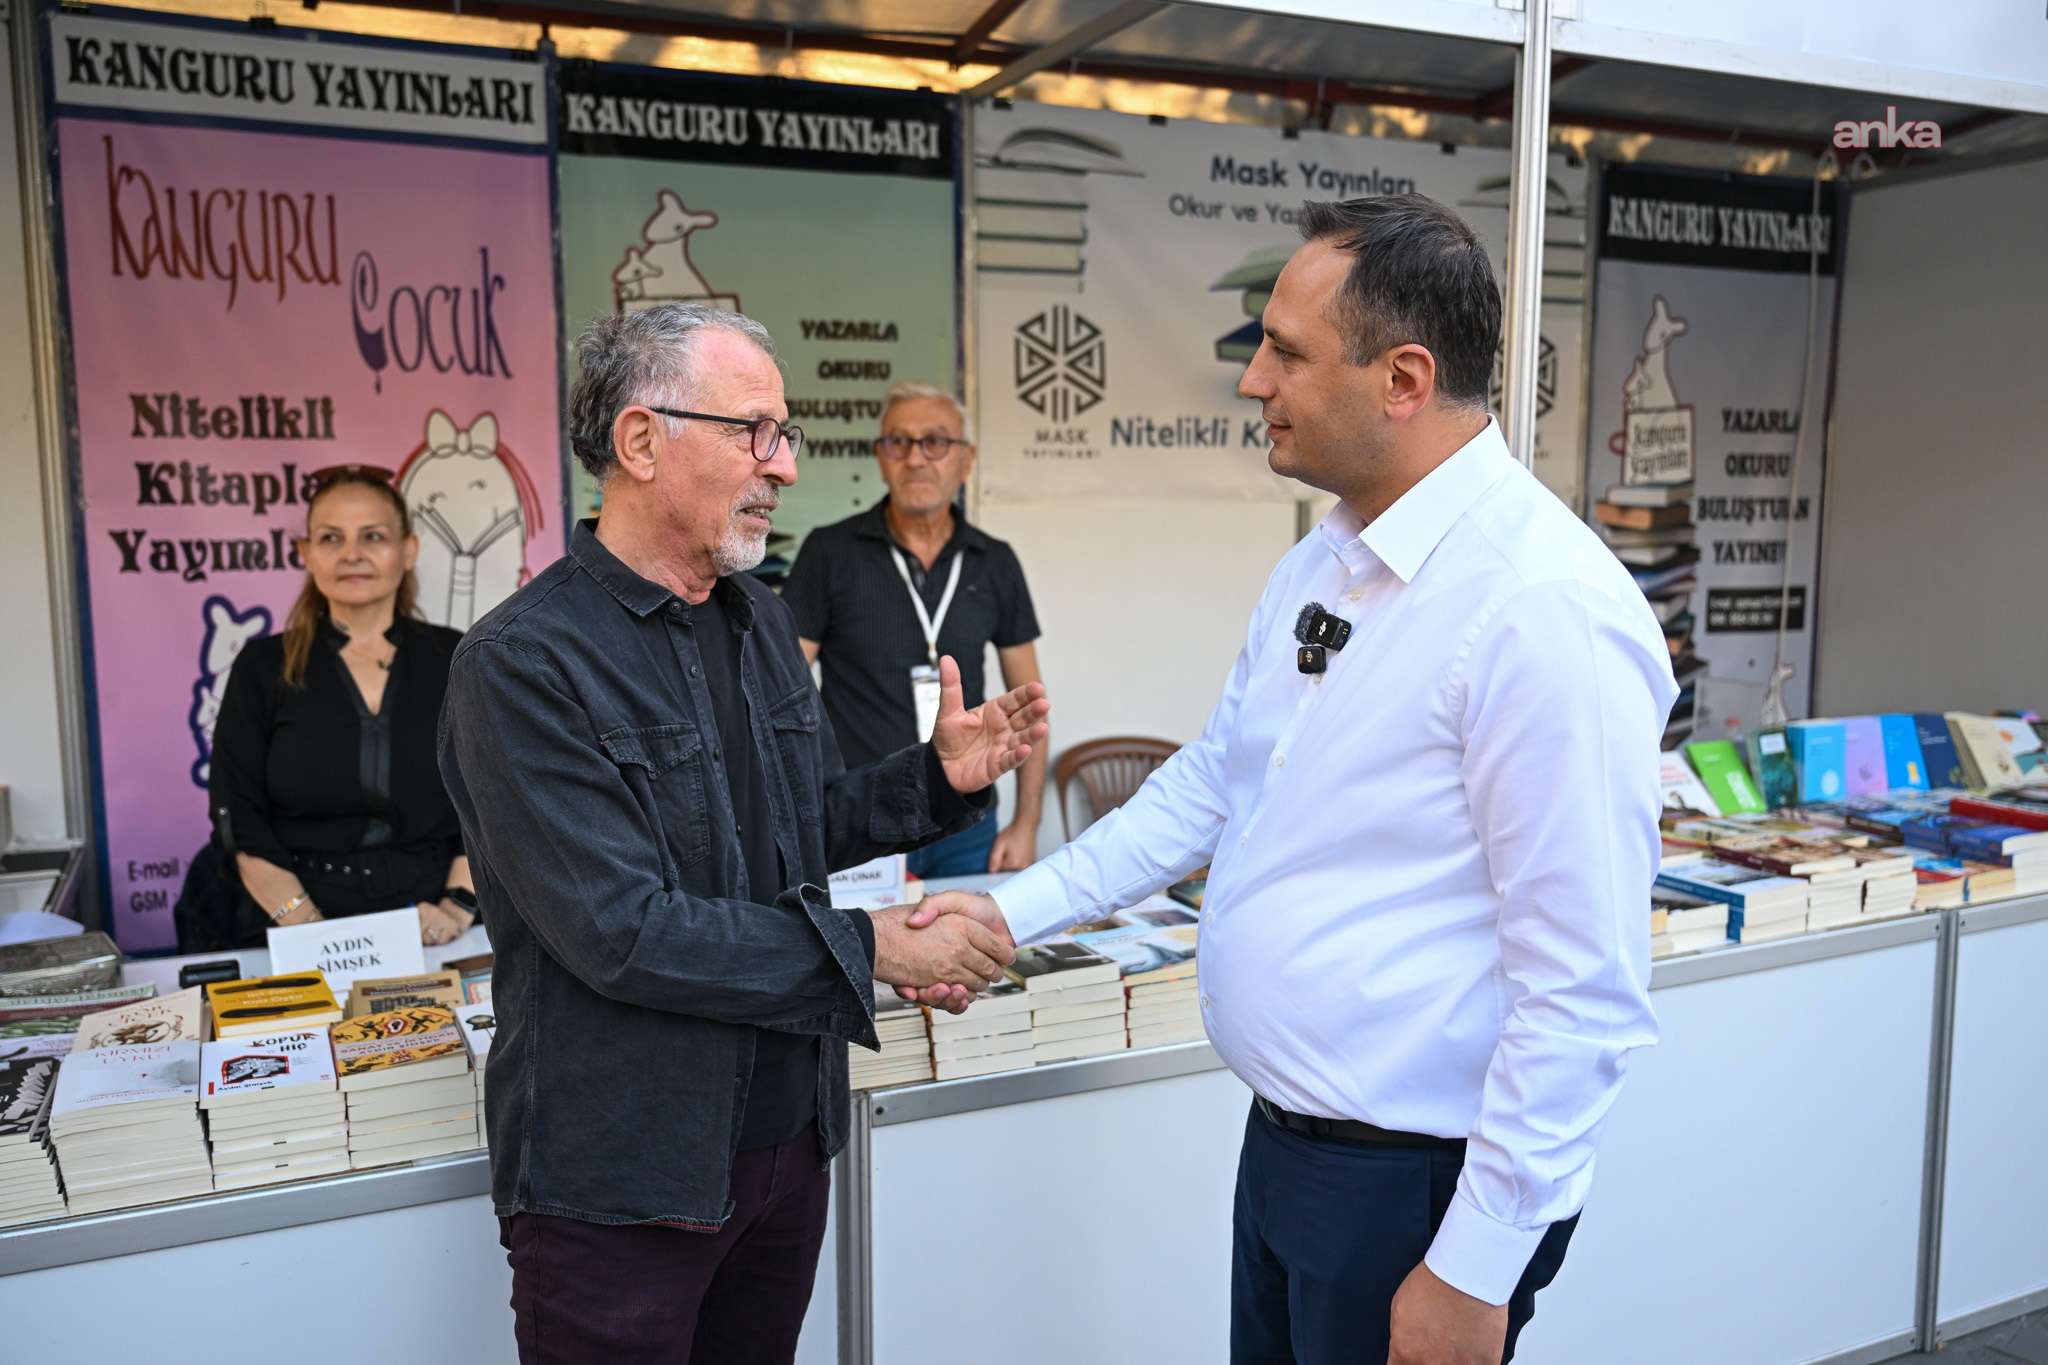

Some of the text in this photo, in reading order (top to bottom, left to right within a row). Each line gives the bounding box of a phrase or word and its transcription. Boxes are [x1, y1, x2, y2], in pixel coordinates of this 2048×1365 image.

[66, 35, 537, 125] KANGURU YAYINLARI
[566, 93, 942, 159] KANGURU YAYINLARI
[1210, 155, 1416, 198] Mask Yayınları
[1168, 193, 1223, 220] Okur
[1231, 204, 1259, 223] ve
[1607, 194, 1832, 254] KANGURU YAYINLARI
[800, 319, 899, 342] YAZARLA
[818, 360, 891, 379] OKURU
[129, 393, 336, 441] Nitelikli
[1035, 429, 1089, 445] MASK
[1110, 417, 1230, 448] Nitelikli
[1725, 453, 1791, 477] OKURU
[127, 857, 180, 882] E-mail
[129, 889, 168, 913] GSM
[320, 936, 374, 954] AYDIN
